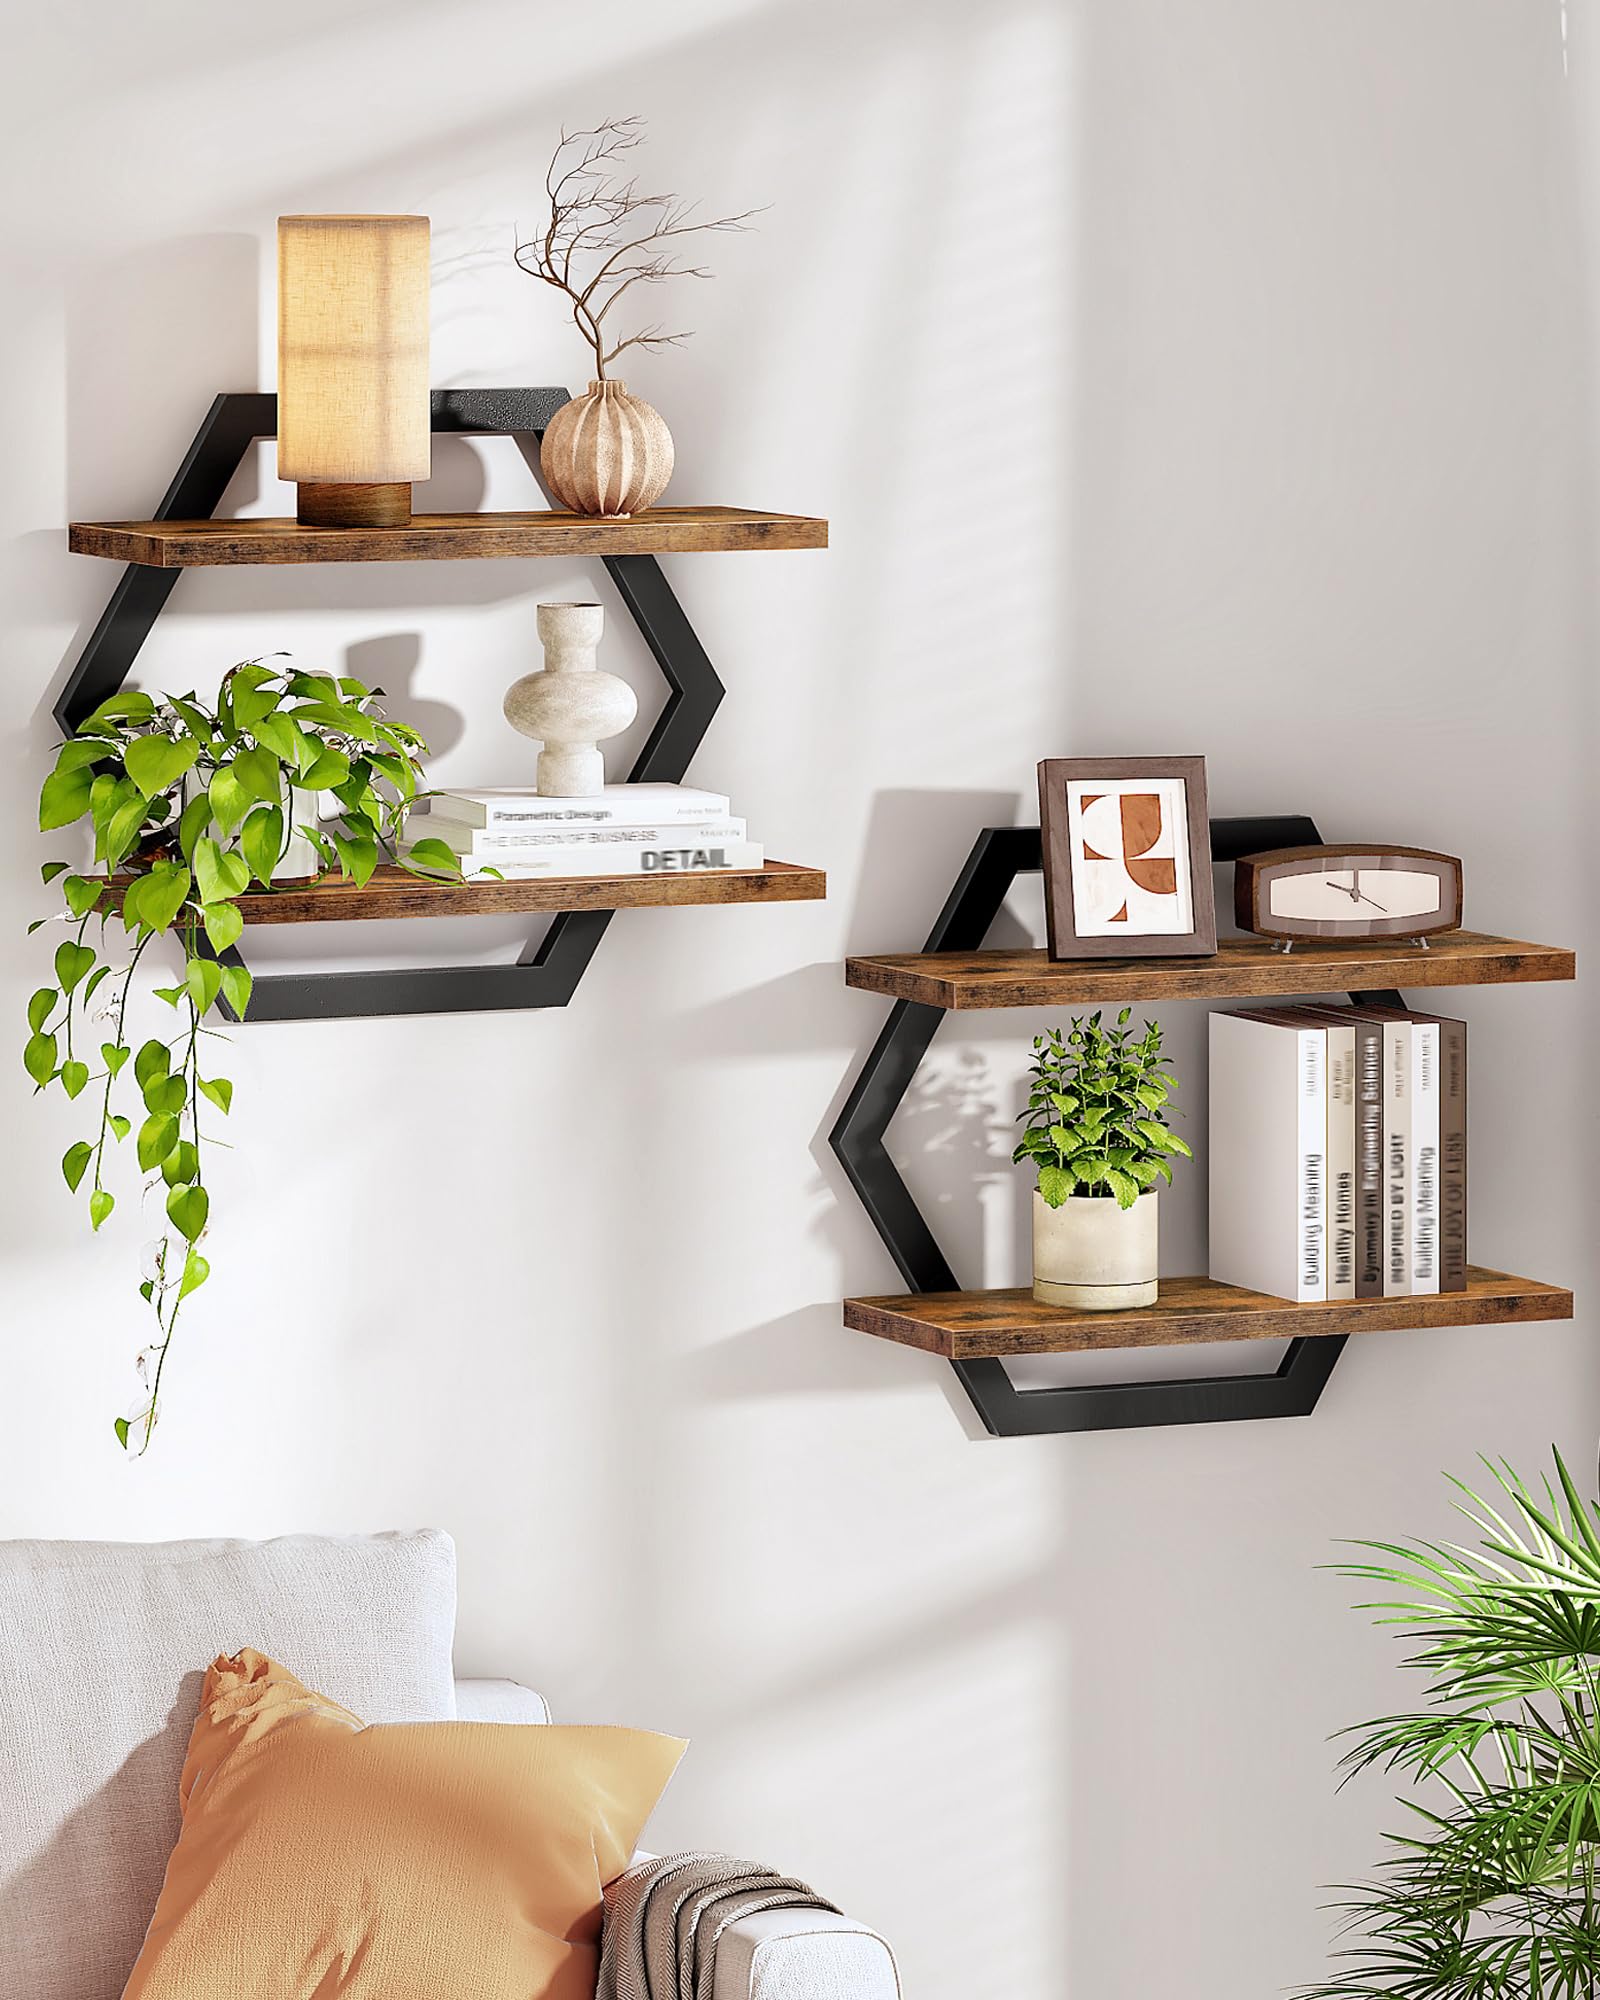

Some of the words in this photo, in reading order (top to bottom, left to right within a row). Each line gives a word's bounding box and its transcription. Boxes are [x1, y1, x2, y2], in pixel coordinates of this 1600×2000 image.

[493, 810, 564, 822] Parametric
[565, 809, 613, 822] Design
[587, 829, 659, 845] BUSINESS
[640, 847, 733, 871] DETAIL
[1361, 1036, 1379, 1101] Sciences
[1361, 1104, 1381, 1191] Engineering
[1390, 1132, 1404, 1180] LIGHT
[1445, 1131, 1463, 1175] LESS
[1303, 1153, 1323, 1220] Meaning
[1335, 1171, 1352, 1224] Homes
[1390, 1183, 1404, 1205] BY
[1416, 1146, 1436, 1213] Meaning
[1445, 1178, 1463, 1205] OF
[1362, 1209, 1380, 1283] Symmetry
[1390, 1209, 1405, 1284] INSPIRED
[1414, 1216, 1436, 1279] Building
[1445, 1206, 1463, 1240] JOY
[1303, 1223, 1323, 1286] Building
[1335, 1227, 1354, 1284] Healthy
[1445, 1243, 1462, 1279] THE
